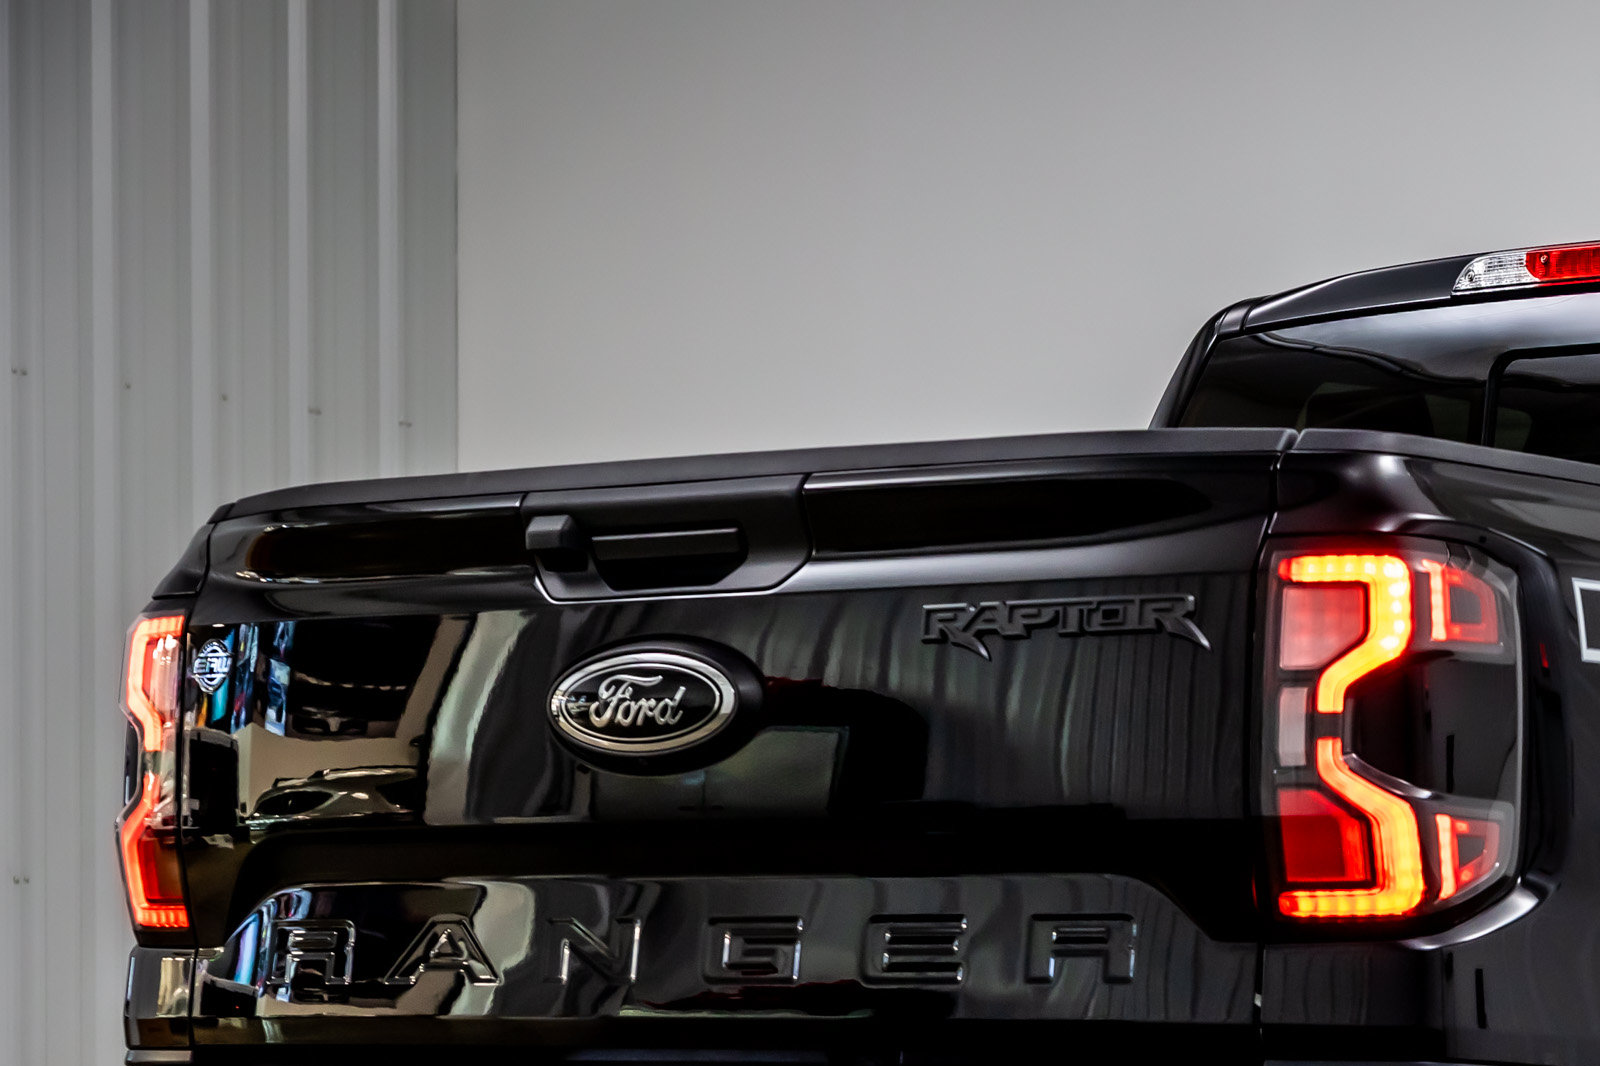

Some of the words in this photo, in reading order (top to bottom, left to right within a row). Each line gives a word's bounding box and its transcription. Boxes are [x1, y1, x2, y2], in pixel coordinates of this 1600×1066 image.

[921, 592, 1213, 662] RAPTOR
[589, 675, 687, 728] Ford
[267, 913, 1138, 988] RANGER
